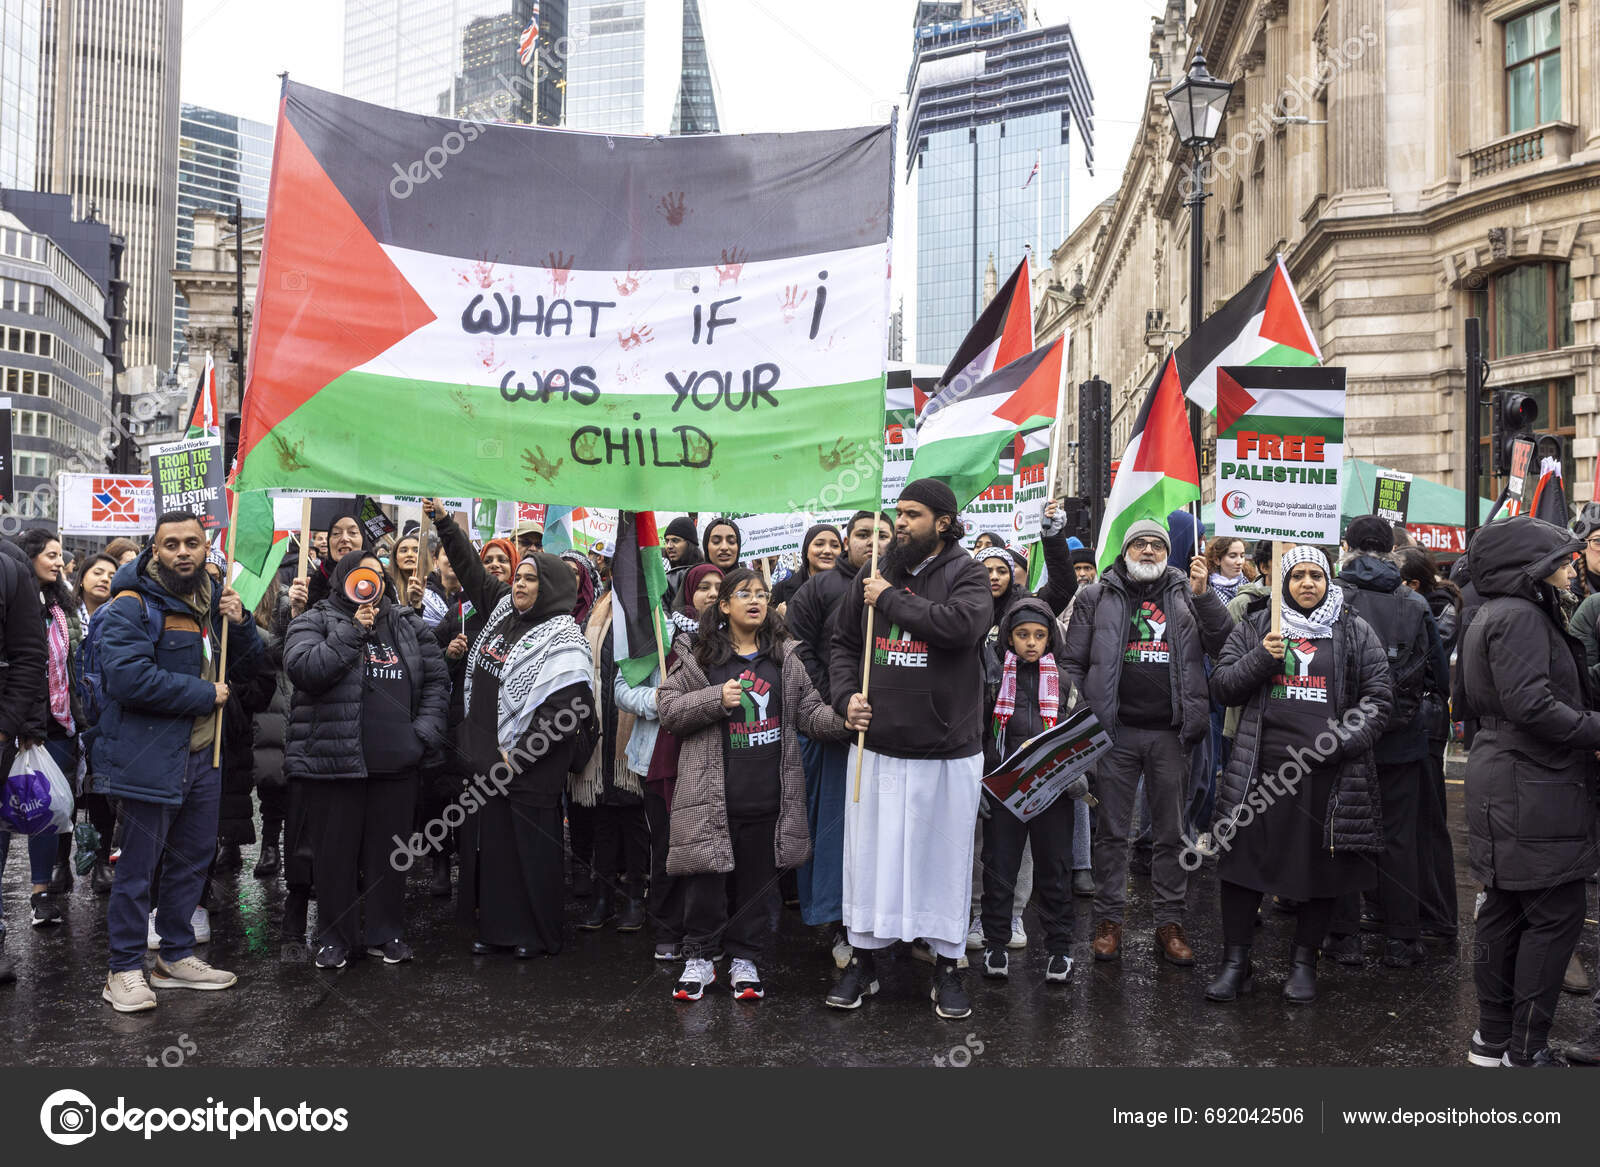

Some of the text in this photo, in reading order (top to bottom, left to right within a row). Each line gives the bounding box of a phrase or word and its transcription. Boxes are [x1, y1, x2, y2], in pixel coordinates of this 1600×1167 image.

[461, 292, 616, 338] WHAT
[500, 362, 781, 413] WAS YOUR
[1237, 431, 1326, 463] FREE
[158, 448, 212, 469] FROM THE
[160, 462, 208, 482] RIVER TO
[1221, 462, 1338, 485] PALESTINE
[160, 476, 205, 495] THE SEA
[979, 485, 1014, 501] REE
[162, 487, 219, 508] PALESTINE
[1256, 508, 1287, 517] Palestinian
[590, 519, 616, 533] NOT
[1234, 525, 1325, 540] WWW.PFBUK.COM
[875, 636, 929, 654] PALESTINE
[887, 651, 929, 667] FREE
[1286, 686, 1328, 703] FREE
[729, 715, 780, 735] PALESTINE
[748, 727, 781, 747] FREE
